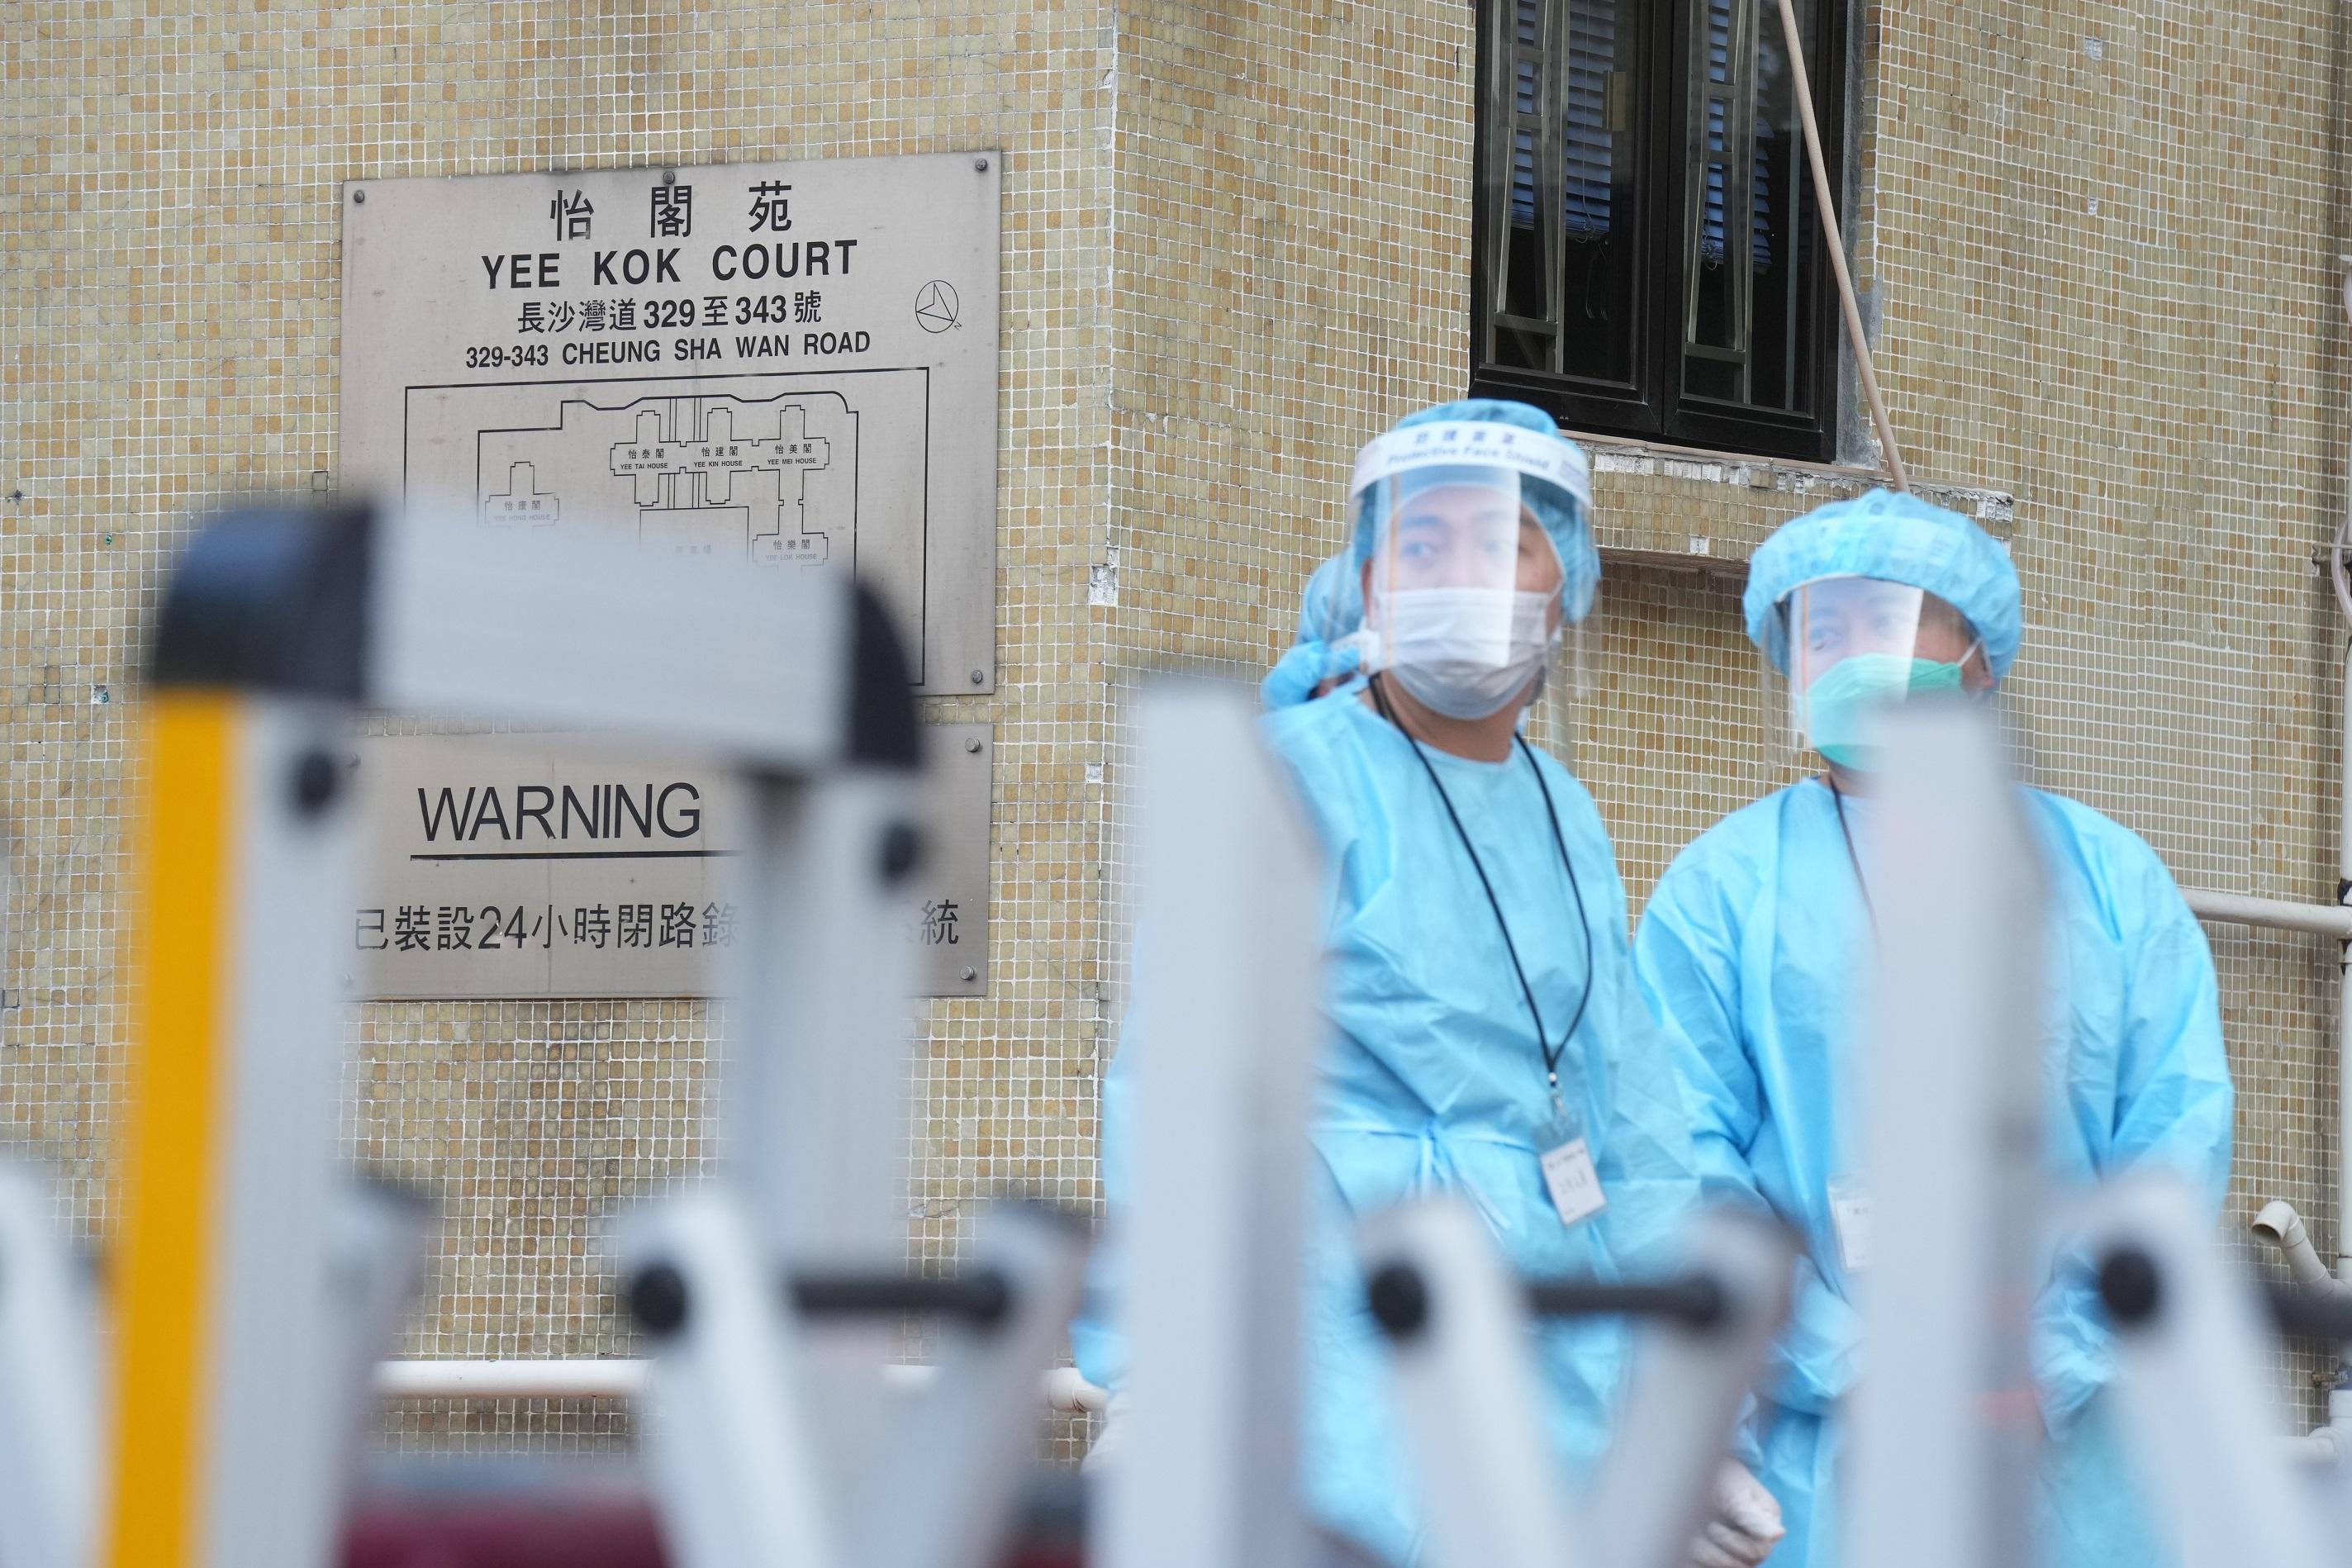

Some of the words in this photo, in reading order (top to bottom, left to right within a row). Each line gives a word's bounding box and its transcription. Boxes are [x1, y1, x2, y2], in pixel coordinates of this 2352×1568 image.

[550, 180, 792, 242] 怡閣苑
[481, 253, 560, 289] YEE
[593, 248, 682, 286] KOK
[712, 239, 858, 281] COURT
[517, 289, 822, 334] 長沙灣道329至343號
[465, 344, 549, 368] 329-343
[562, 340, 660, 365] CHEUNG
[674, 337, 722, 361] SHA
[735, 335, 789, 358] WAN
[804, 330, 871, 355] ROAD
[628, 448, 665, 459] 怡泰閣
[701, 445, 739, 457] 怡建閣
[775, 443, 812, 454] 怡美閣
[529, 513, 551, 521] HOUSE
[772, 539, 810, 550] 怡樂閣
[417, 782, 701, 841] WARNING
